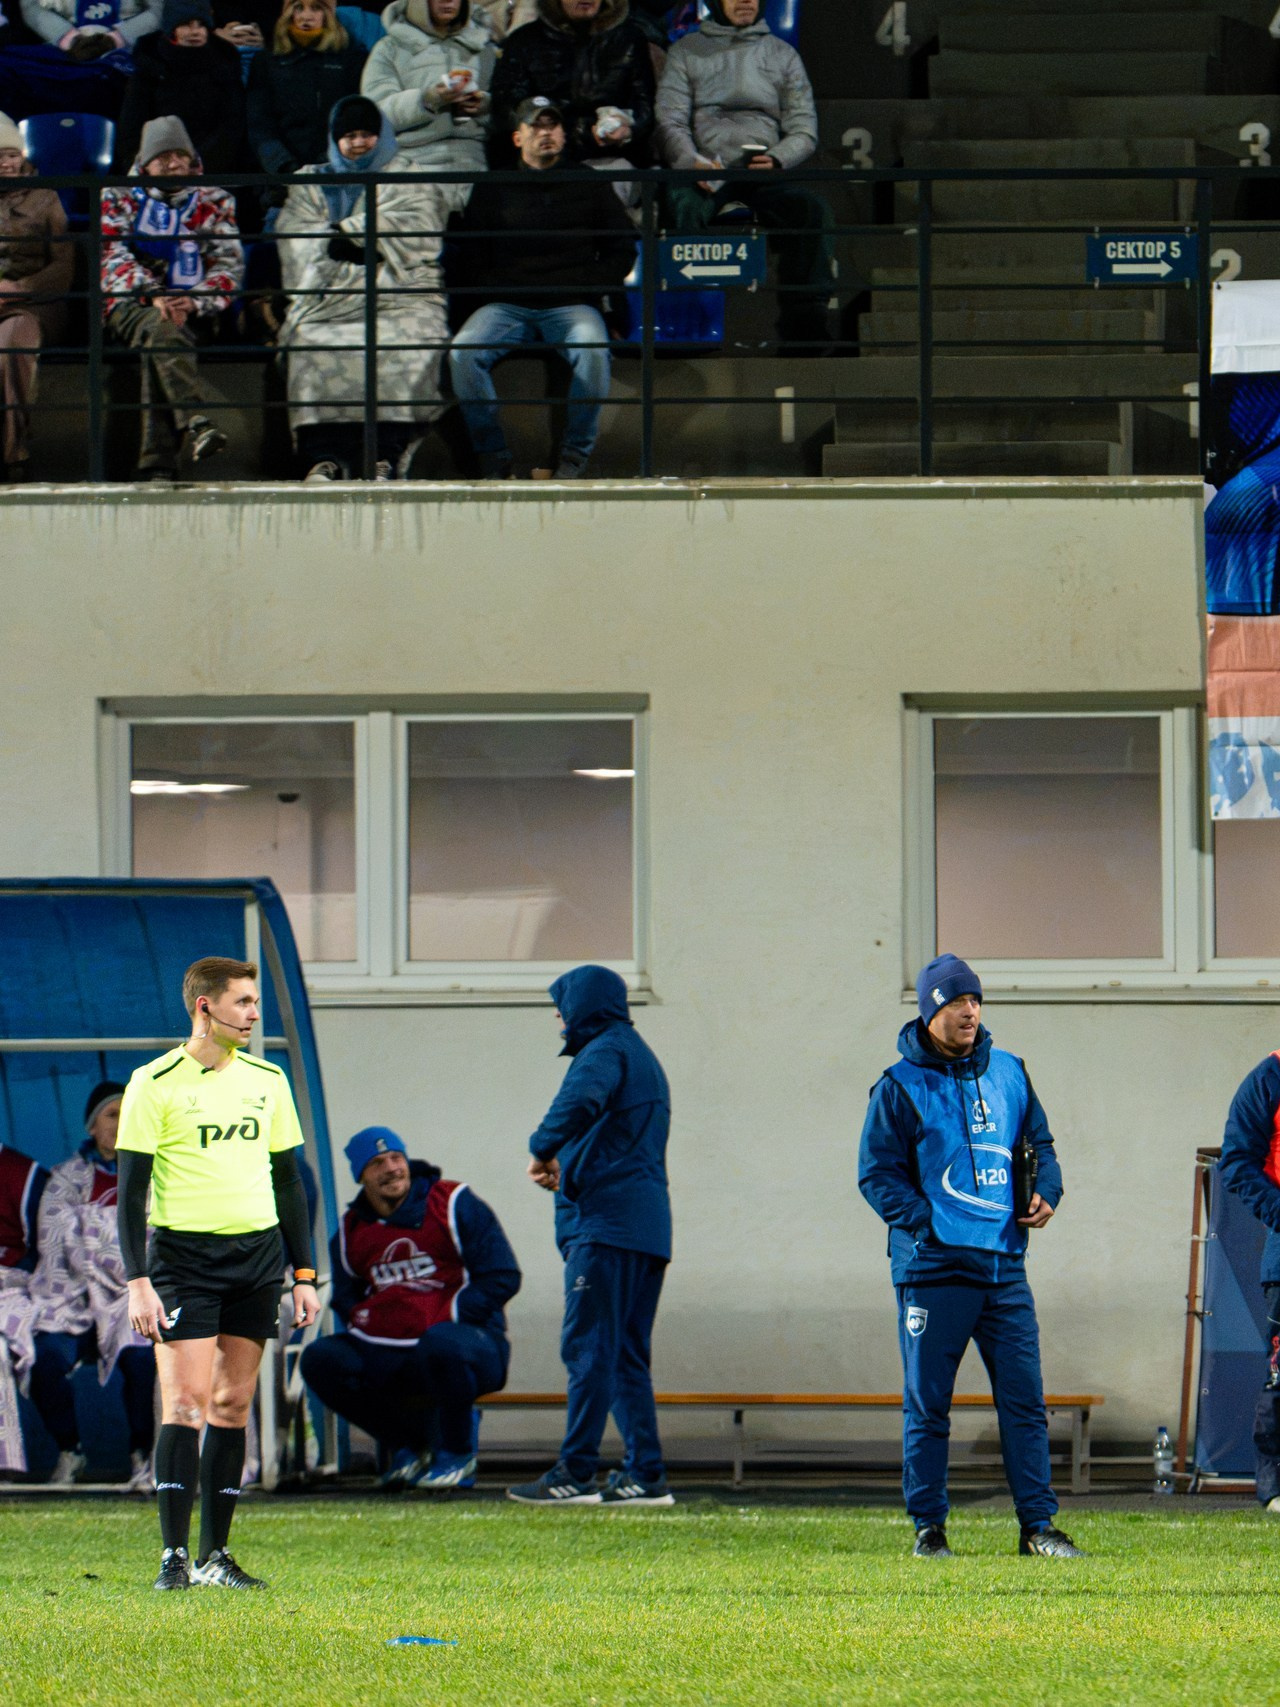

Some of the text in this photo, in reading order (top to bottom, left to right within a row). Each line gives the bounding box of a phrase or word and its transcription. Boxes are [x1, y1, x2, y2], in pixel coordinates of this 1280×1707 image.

[875, 1, 911, 56] 4
[842, 127, 874, 182] 3
[1239, 122, 1272, 167] 3
[672, 243, 749, 261] СЕКТОР 4
[1105, 241, 1182, 259] СЕКТОР 5
